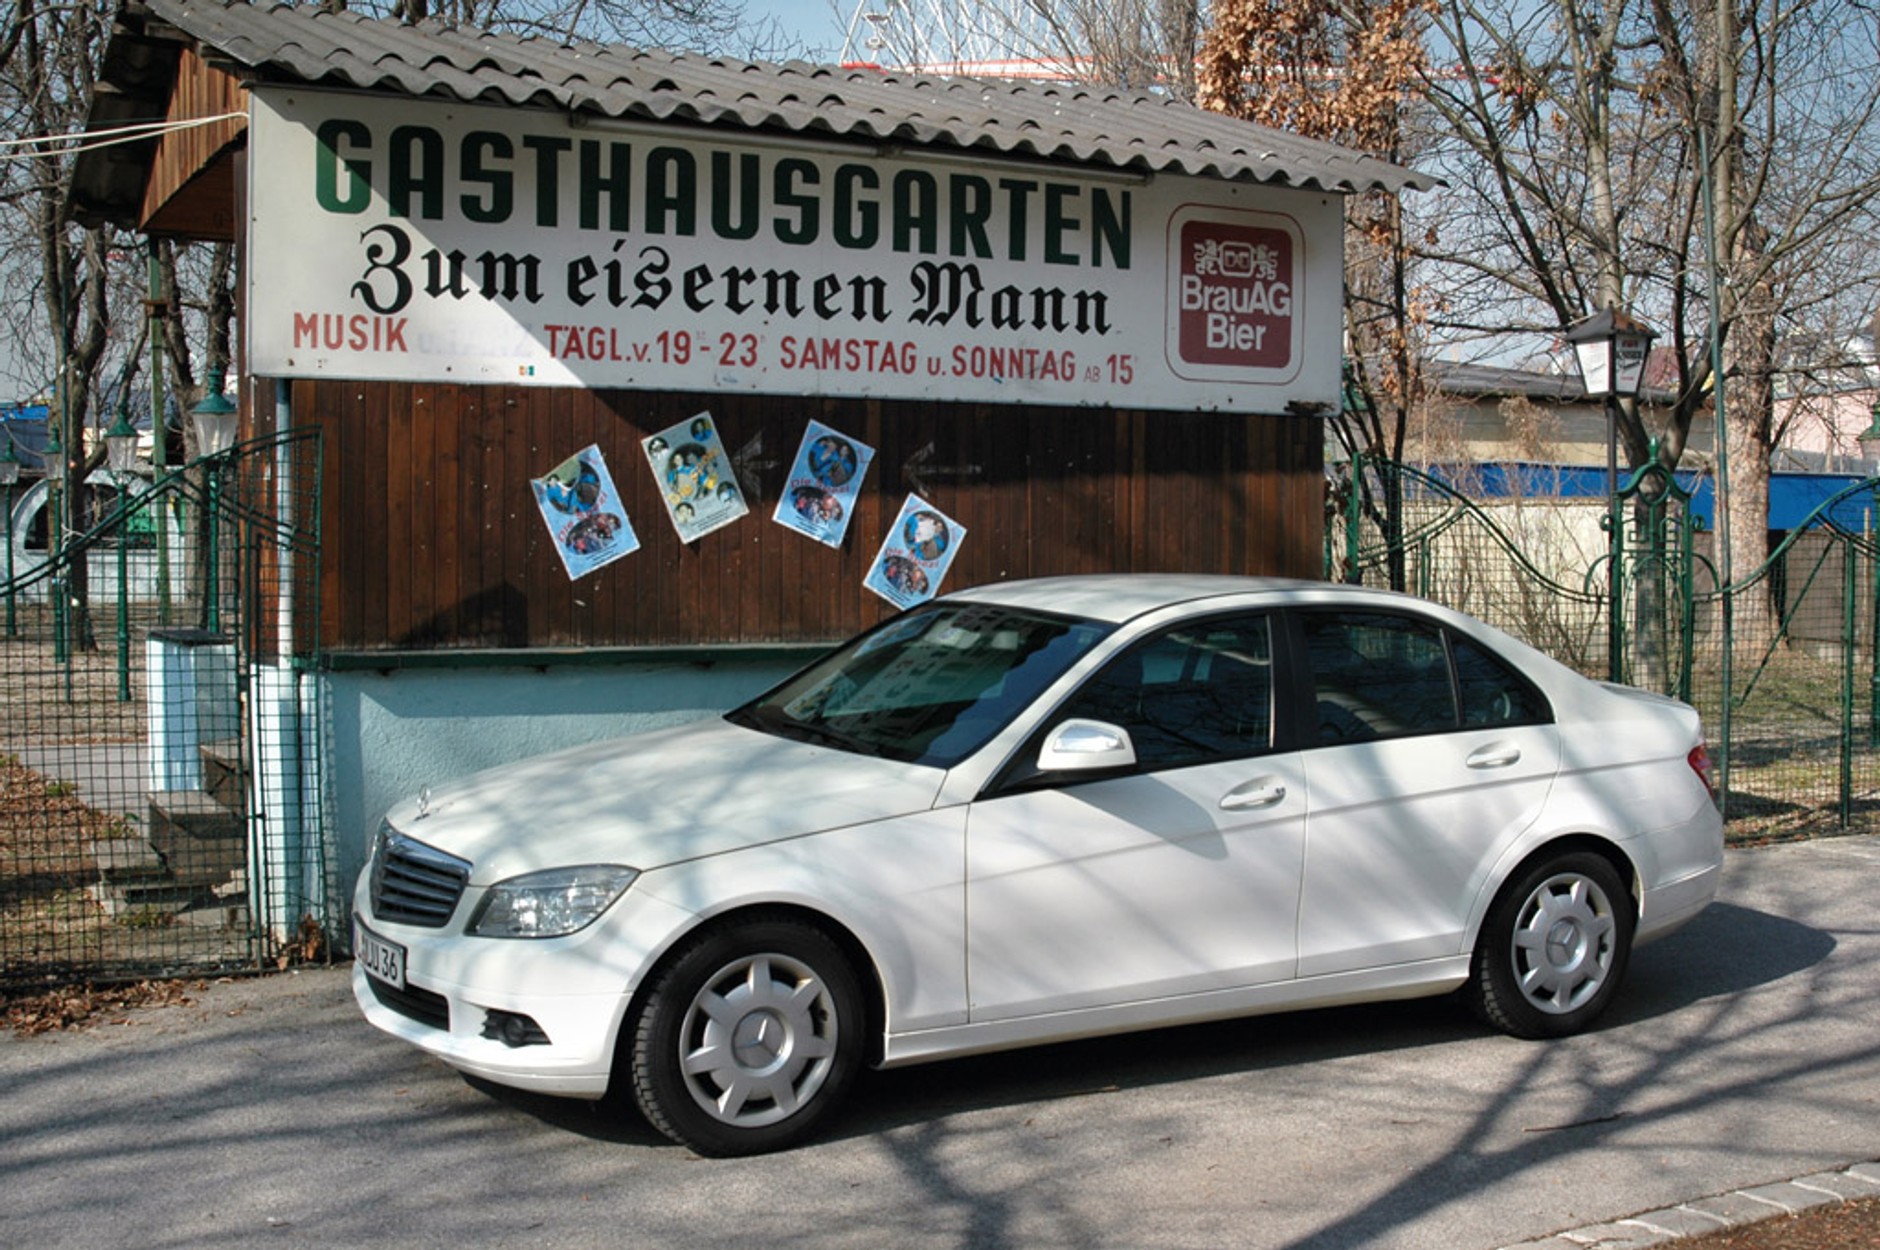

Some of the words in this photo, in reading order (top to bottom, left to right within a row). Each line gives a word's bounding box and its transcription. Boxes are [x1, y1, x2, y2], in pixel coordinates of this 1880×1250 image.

[315, 119, 1132, 270] GASTHAUSGARTEN
[350, 223, 544, 315] Zum
[567, 239, 893, 323] eisernen
[908, 260, 1112, 336] Mann
[1182, 274, 1292, 317] BrauAG
[292, 313, 409, 353] MUSIK
[780, 335, 917, 375] SAMSTAG
[952, 344, 1076, 382] SONNTAG
[1206, 312, 1266, 351] Bier
